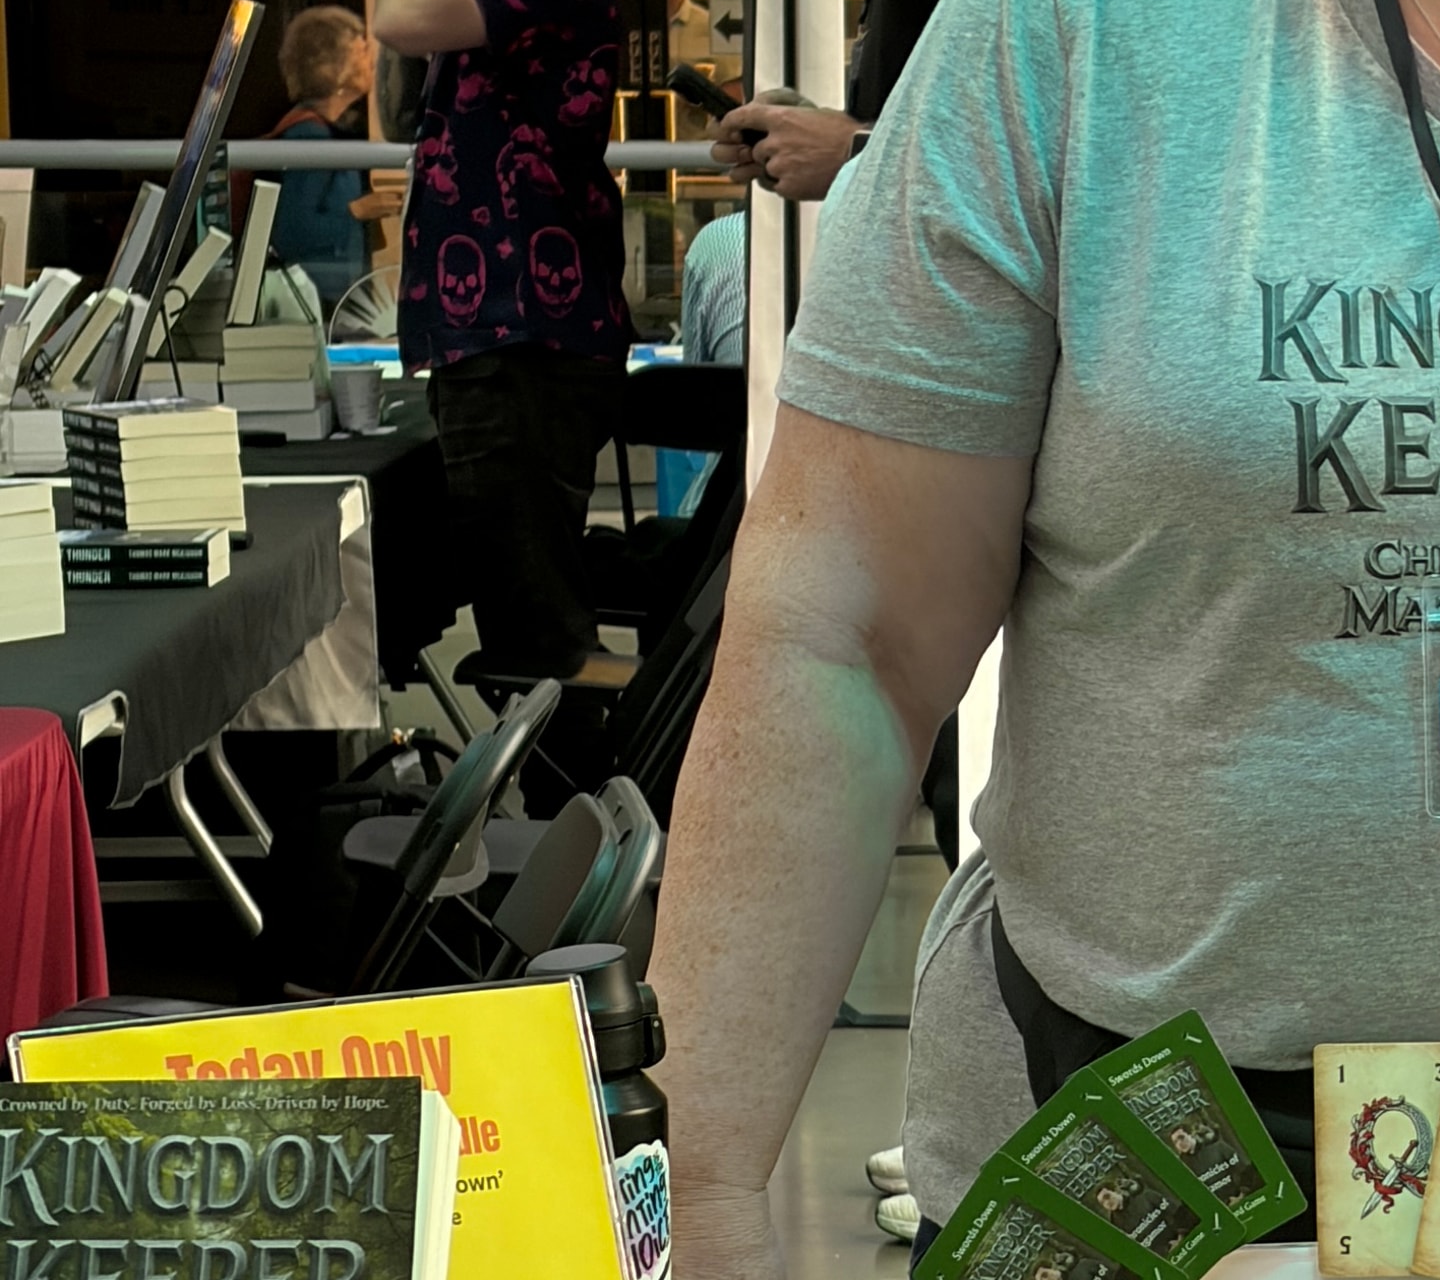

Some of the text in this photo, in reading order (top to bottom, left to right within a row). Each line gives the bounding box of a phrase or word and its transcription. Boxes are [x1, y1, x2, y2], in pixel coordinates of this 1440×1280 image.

[1108, 1047, 1171, 1087] Swords Down
[1337, 1065, 1345, 1083] 1
[0, 1097, 67, 1112] Crowned
[72, 1096, 88, 1113] by
[140, 1096, 194, 1113] Forged
[199, 1096, 215, 1112] by
[265, 1096, 317, 1110] Driven
[322, 1096, 339, 1111] by
[0, 1128, 394, 1227] KINGDOM
